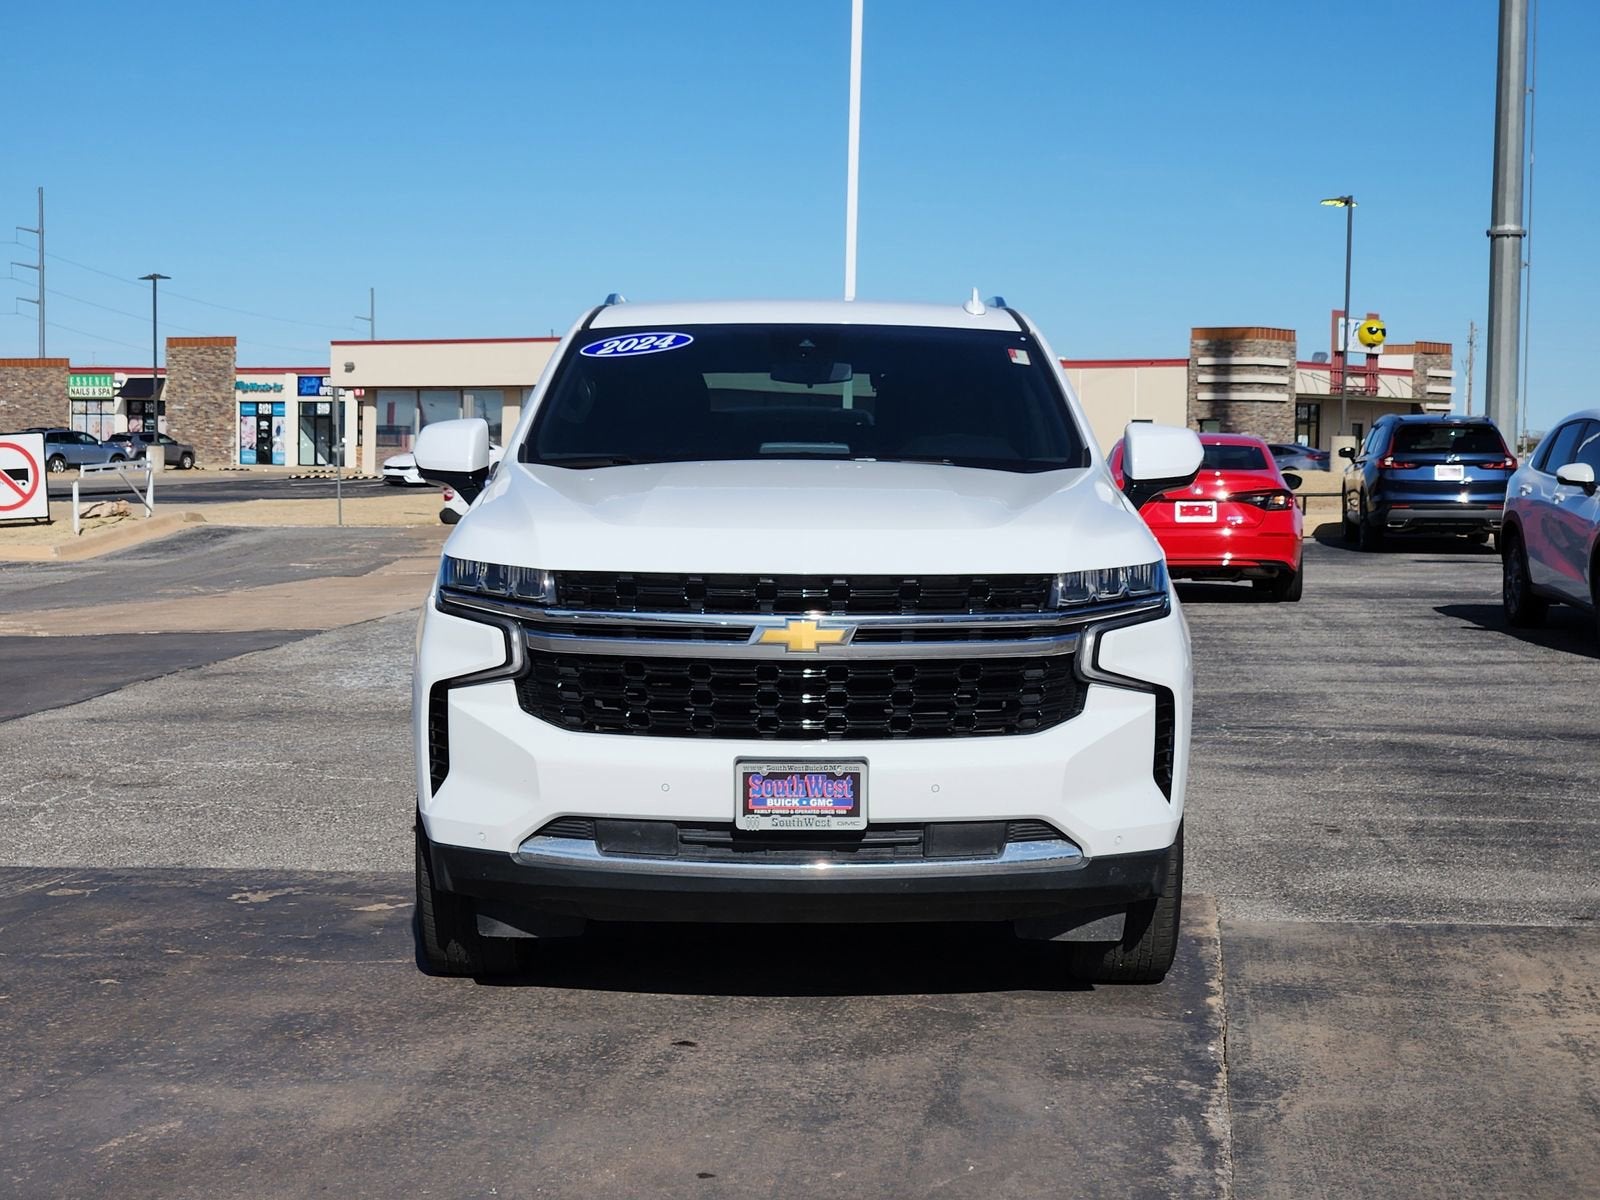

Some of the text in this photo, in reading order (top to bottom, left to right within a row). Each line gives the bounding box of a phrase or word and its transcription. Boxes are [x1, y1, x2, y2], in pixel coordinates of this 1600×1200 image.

[596, 335, 676, 355] 2024
[70, 376, 111, 387] ESSENCE
[71, 387, 110, 396] NAILS & SPA
[743, 764, 860, 772] wwwSouthWestBuickGMC.com
[749, 774, 854, 798] SouthWest
[766, 798, 834, 807] BUICK GMC
[772, 817, 832, 828] SouthWest
